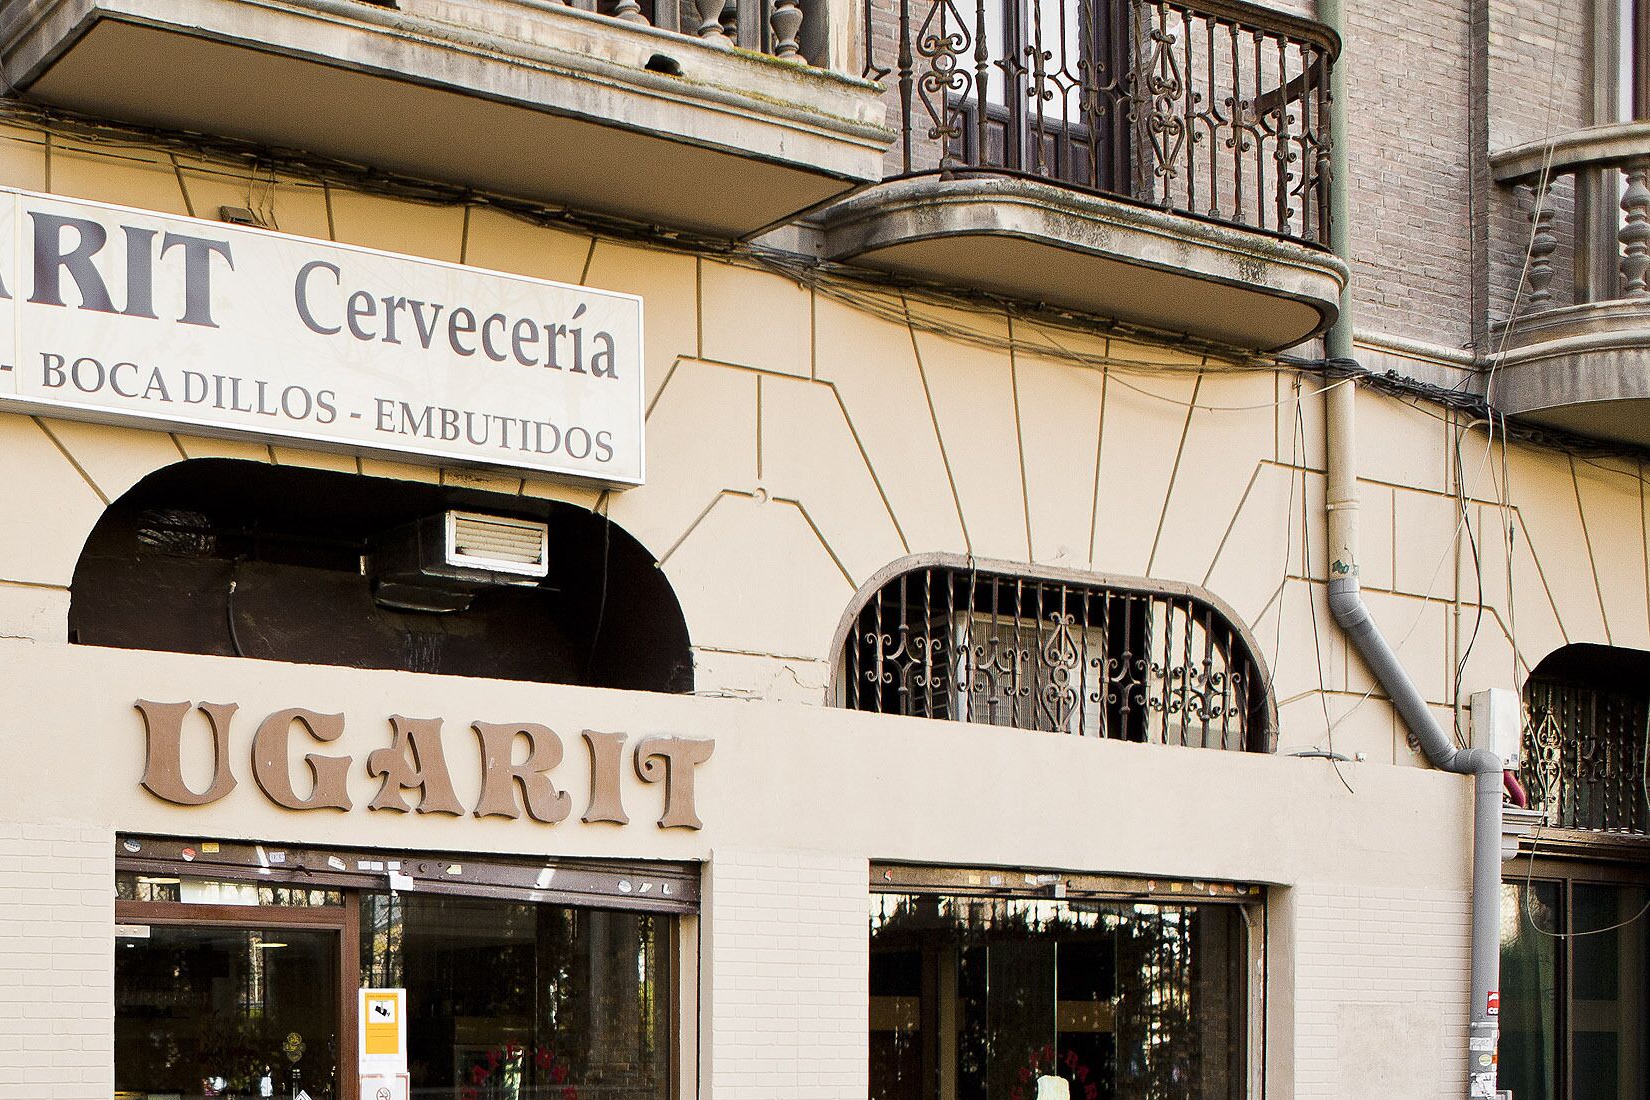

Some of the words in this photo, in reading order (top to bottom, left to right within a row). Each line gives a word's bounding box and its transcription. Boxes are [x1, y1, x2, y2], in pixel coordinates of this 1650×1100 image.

[295, 260, 619, 380] Cervecería
[41, 353, 337, 425] BOCADILLOS
[374, 398, 614, 464] EMBUTIDOS
[133, 697, 716, 831] UGARIT
